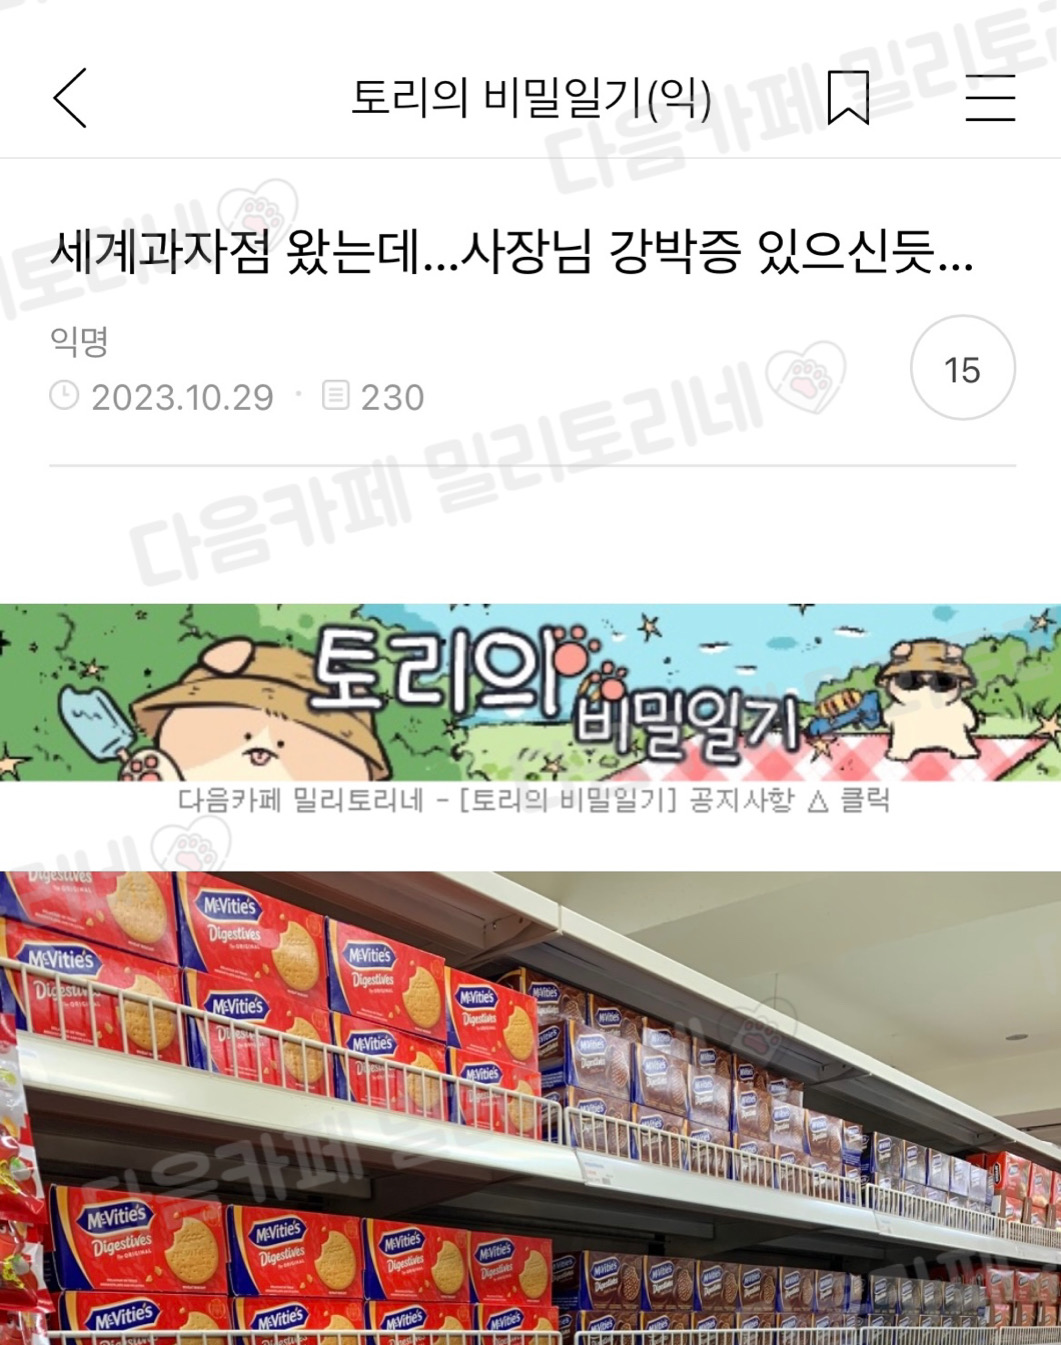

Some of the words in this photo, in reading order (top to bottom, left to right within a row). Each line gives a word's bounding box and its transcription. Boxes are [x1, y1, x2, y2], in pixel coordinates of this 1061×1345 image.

[352, 77, 467, 118] 토리의
[486, 77, 711, 123] 비밀일기(익)
[51, 229, 269, 275] 세계과자점
[287, 229, 590, 275] 왔는데...사장님
[611, 229, 742, 275] 강박증
[759, 229, 973, 275] 있으신듯...
[51, 326, 107, 358] 익명
[945, 357, 980, 384] 15
[92, 384, 273, 411] 2023.10.29
[362, 384, 424, 411] 230
[311, 626, 557, 718] 토리의
[574, 690, 804, 765] 비밀일기
[179, 787, 281, 813] 다음카페
[461, 787, 547, 813] [토리의
[561, 787, 676, 813] 비밀일기]
[690, 787, 796, 813] 공지사항
[841, 787, 889, 813] 클릭
[205, 898, 256, 914] McVitie's
[207, 925, 261, 943] Digestives
[353, 972, 394, 988] Digestives
[88, 1204, 146, 1230] McVitie's
[256, 1219, 301, 1243] McVitie's
[385, 1231, 421, 1252] McVitie's
[91, 1234, 152, 1257] Digestives
[260, 1246, 305, 1267] Digestives
[387, 1254, 423, 1273] Digestives
[96, 1304, 153, 1330] McVitie's
